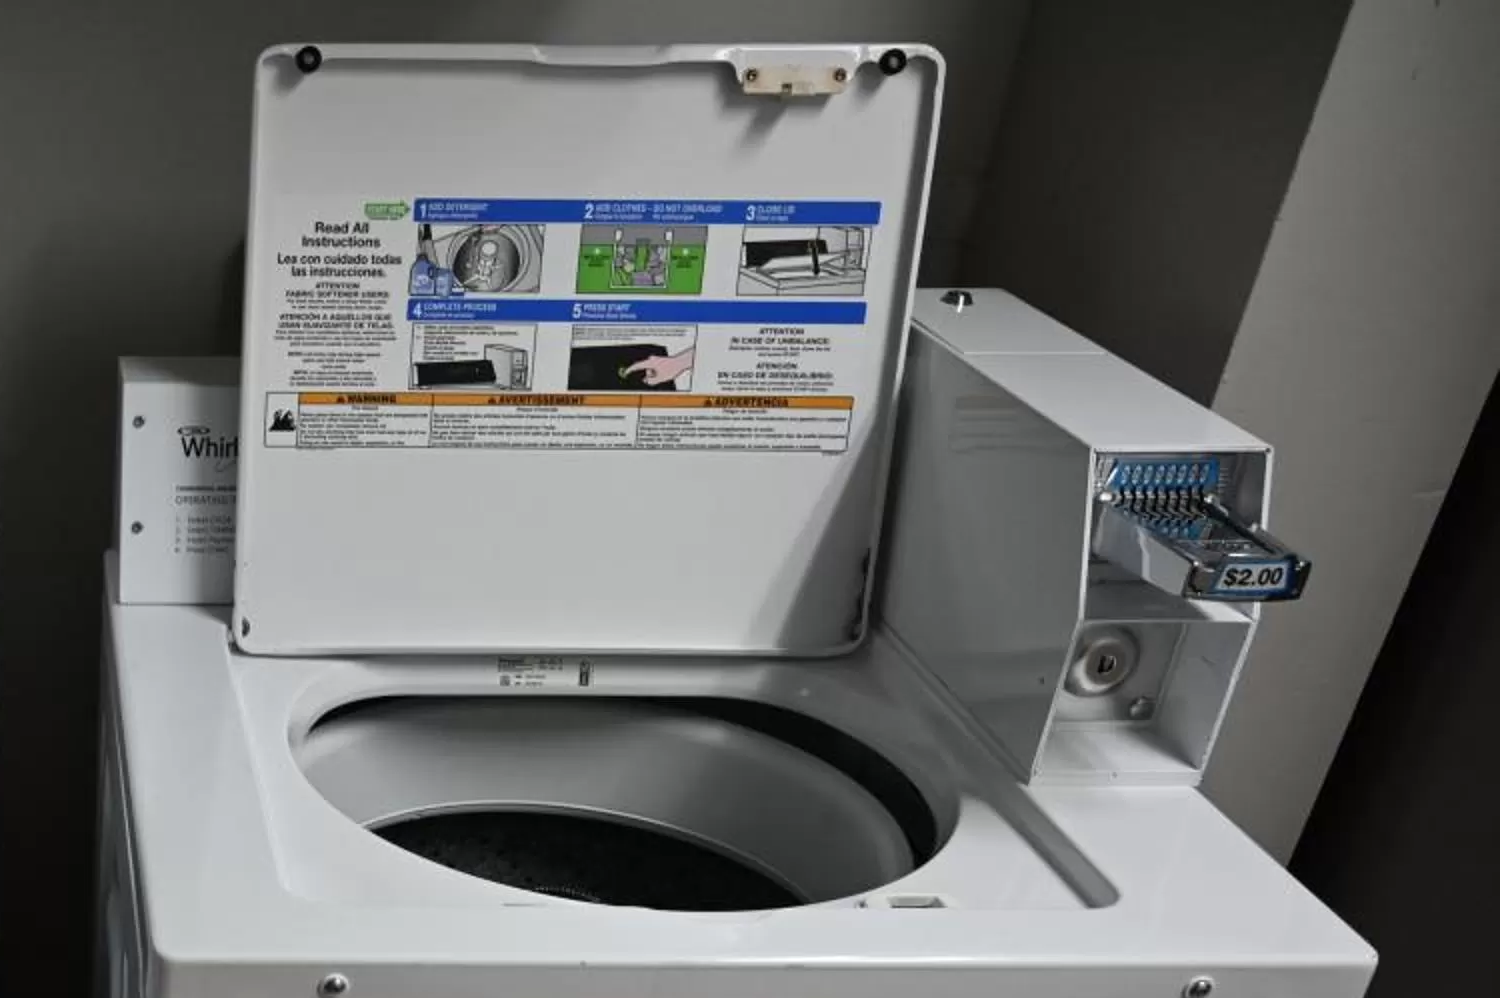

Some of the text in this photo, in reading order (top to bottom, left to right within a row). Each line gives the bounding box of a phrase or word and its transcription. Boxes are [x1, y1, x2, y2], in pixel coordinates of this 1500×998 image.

[418, 203, 428, 219] 1
[583, 203, 595, 219] 2
[745, 204, 756, 221] 3
[315, 222, 370, 234] Read All
[302, 235, 381, 248] Instructions
[277, 252, 403, 265] Lea con cuidado todas
[292, 265, 386, 278] las instrucciones.
[412, 302, 422, 318] 4
[572, 303, 582, 319] 5
[347, 394, 397, 404] WARNING
[497, 395, 585, 406] AVERTISSEMENT
[714, 396, 789, 407] ADVERTENCIA
[1223, 567, 1284, 587] $2.00
